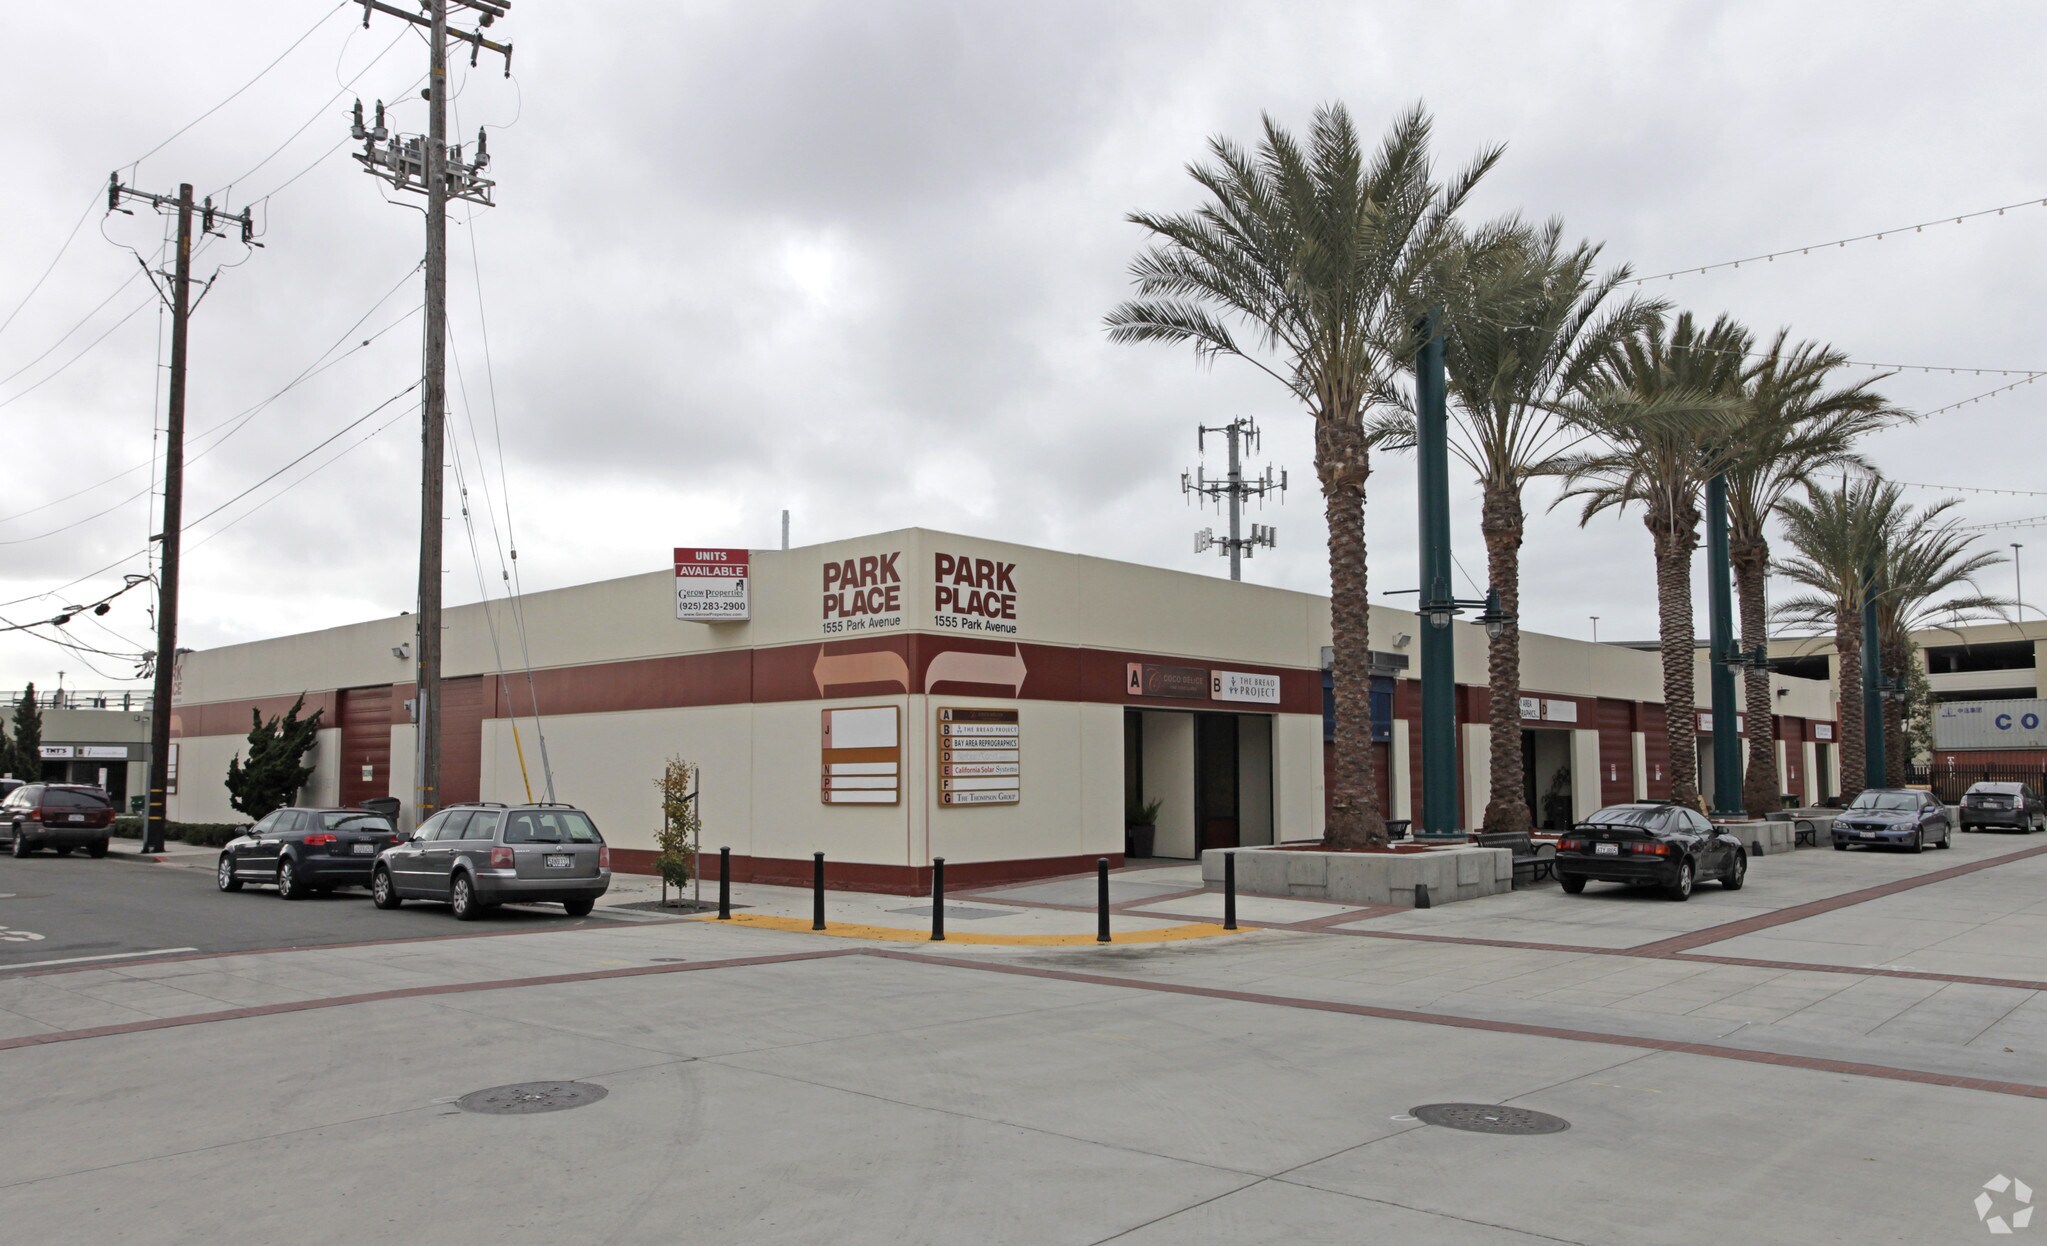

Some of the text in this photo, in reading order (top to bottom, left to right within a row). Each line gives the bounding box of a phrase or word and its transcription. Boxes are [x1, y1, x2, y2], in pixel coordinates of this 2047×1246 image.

[695, 552, 727, 560] UNITS
[680, 566, 744, 576] AVAILABLE
[823, 552, 901, 592] PARK
[935, 552, 1016, 592] PARK
[706, 588, 744, 599] Properties
[680, 602, 746, 610] (925) 283-2900
[823, 585, 900, 619] PLACE
[935, 586, 1016, 620] PLACE
[822, 616, 900, 633] 1555 Park Avenue
[934, 616, 1016, 633] 1555 Park Avenue
[1131, 670, 1140, 687] A
[1214, 678, 1221, 692] B
[1254, 678, 1275, 686] BREAD
[1240, 687, 1275, 698] PROJECT
[1543, 704, 1547, 715] D
[944, 710, 950, 720] A
[825, 725, 829, 734] J
[944, 725, 950, 734] B
[944, 739, 950, 747] C
[944, 752, 950, 761] D
[825, 765, 829, 774] N
[944, 766, 949, 775] E
[825, 778, 830, 787] P
[944, 780, 948, 789] F
[944, 793, 951, 803] G
